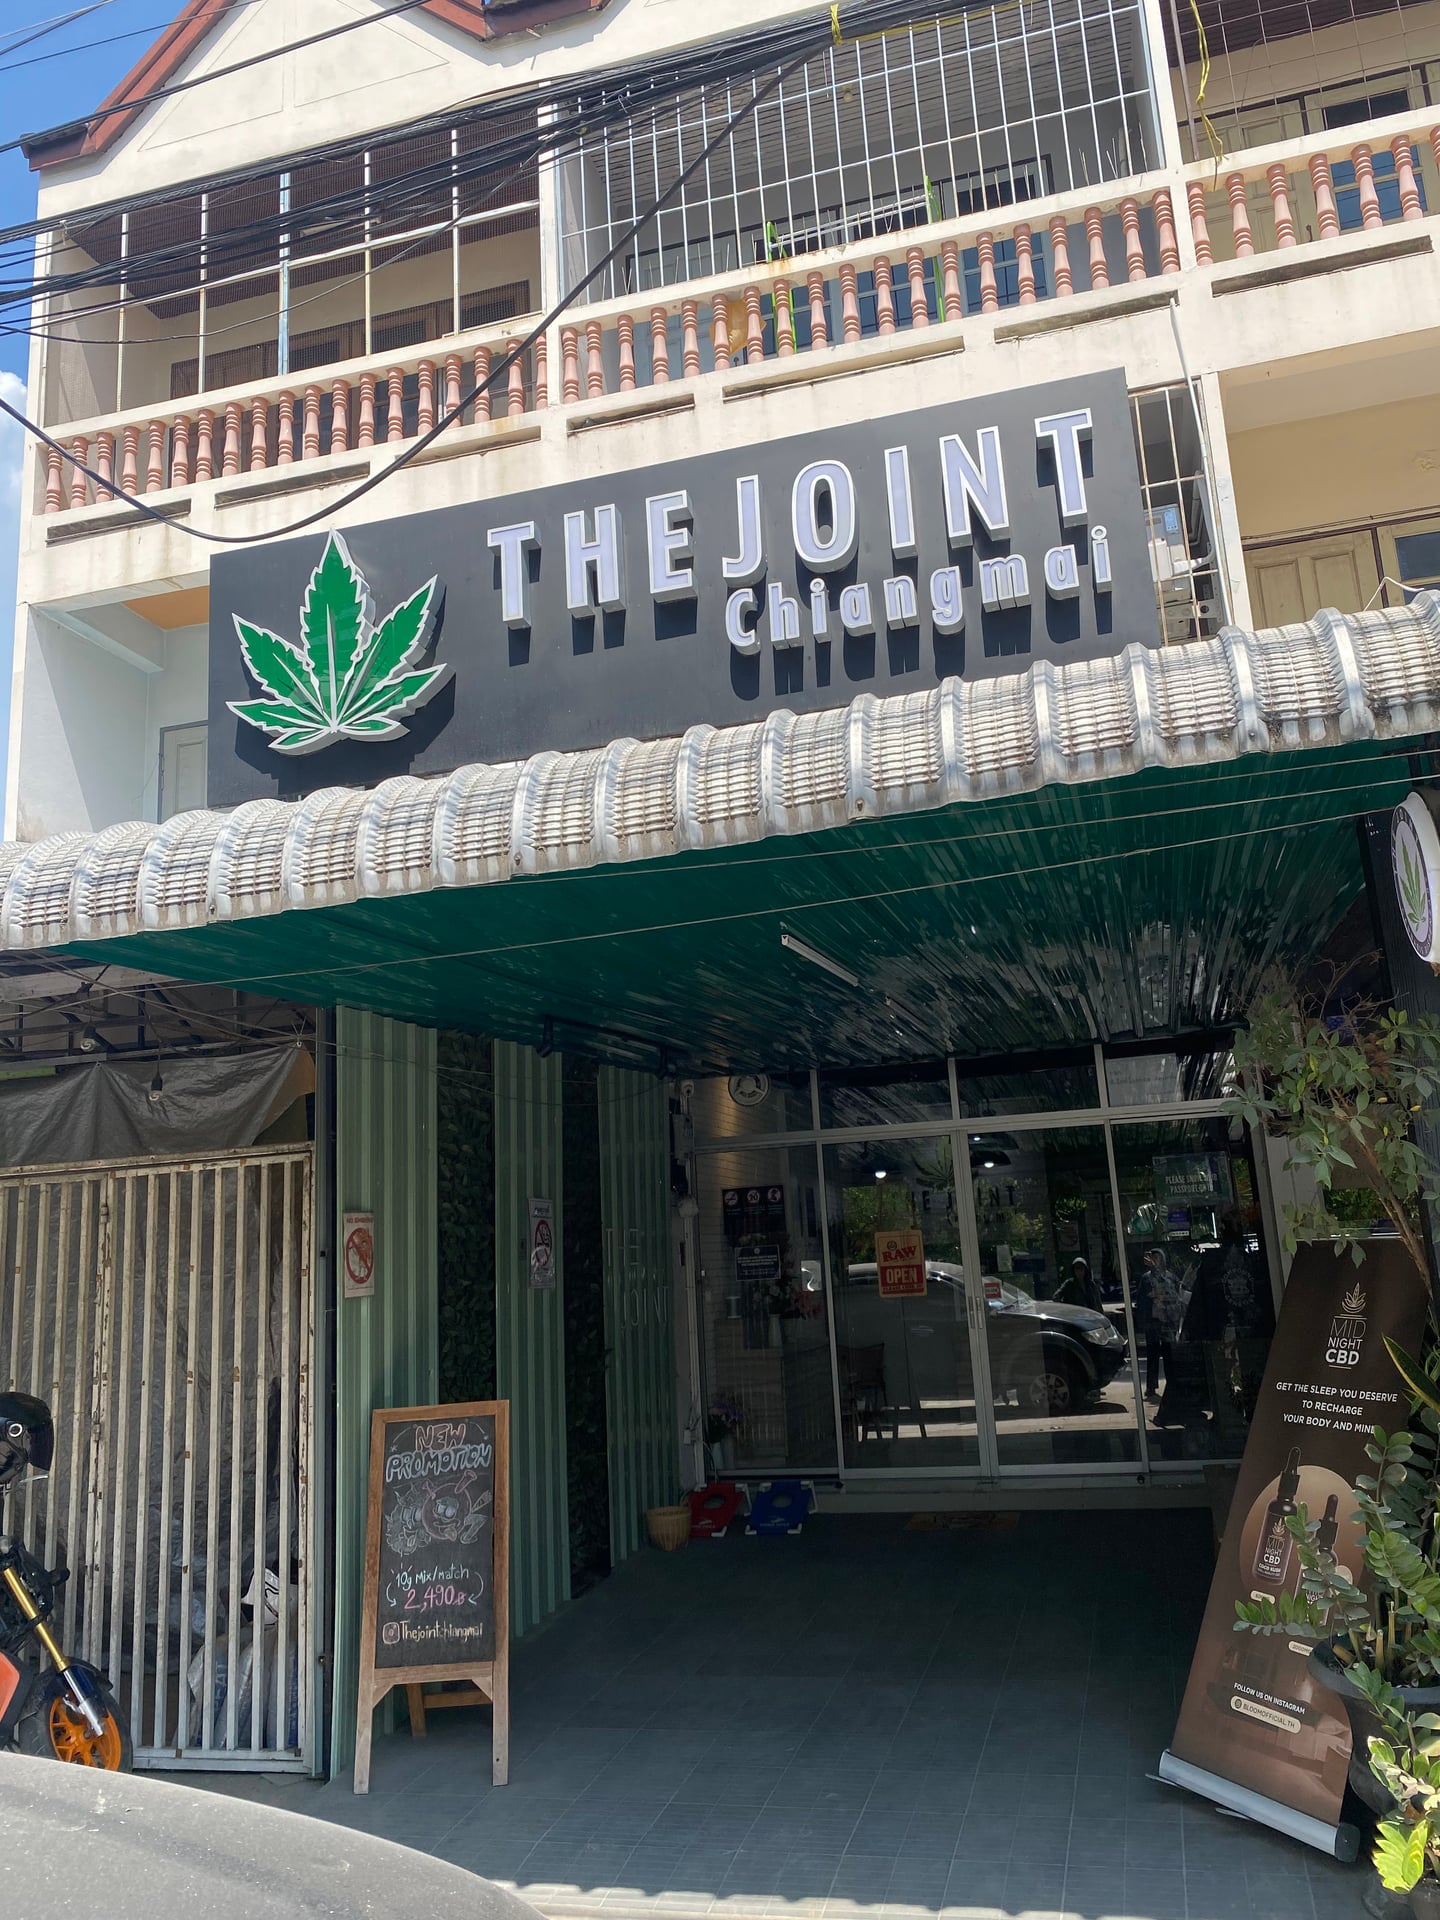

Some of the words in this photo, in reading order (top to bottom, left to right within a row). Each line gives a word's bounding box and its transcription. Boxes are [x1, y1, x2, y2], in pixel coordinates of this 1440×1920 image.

[487, 489, 698, 629] THE
[722, 407, 1093, 587] JOINT
[725, 525, 1113, 654] Chiangmai
[881, 1245, 917, 1263] RAW
[885, 1267, 918, 1284] OPEN
[1330, 1318, 1367, 1339] MID
[1327, 1337, 1364, 1350] NIGHT
[1325, 1348, 1360, 1366] CBD
[1276, 1381, 1293, 1392] GET
[1294, 1383, 1309, 1393] THE
[1310, 1384, 1338, 1397] SLEEP
[1339, 1388, 1358, 1399] YOU
[1358, 1391, 1398, 1403] DESERVE
[1302, 1399, 1313, 1409] TO
[1314, 1401, 1364, 1416] RECHARGE
[1283, 1413, 1304, 1424] YOUR
[1306, 1416, 1331, 1428] BODY
[1332, 1420, 1352, 1431] AND
[415, 1422, 467, 1452] NEW
[385, 1443, 493, 1484] PROMOTION
[1263, 1553, 1281, 1565] CBD
[1265, 1547, 1283, 1557] NIGHT
[395, 1571, 412, 1591] 10g
[1234, 1682, 1255, 1696] FOLLOW
[1255, 1690, 1264, 1698] US
[1264, 1694, 1273, 1703] ON
[1273, 1697, 1306, 1714] INSTAGRAM
